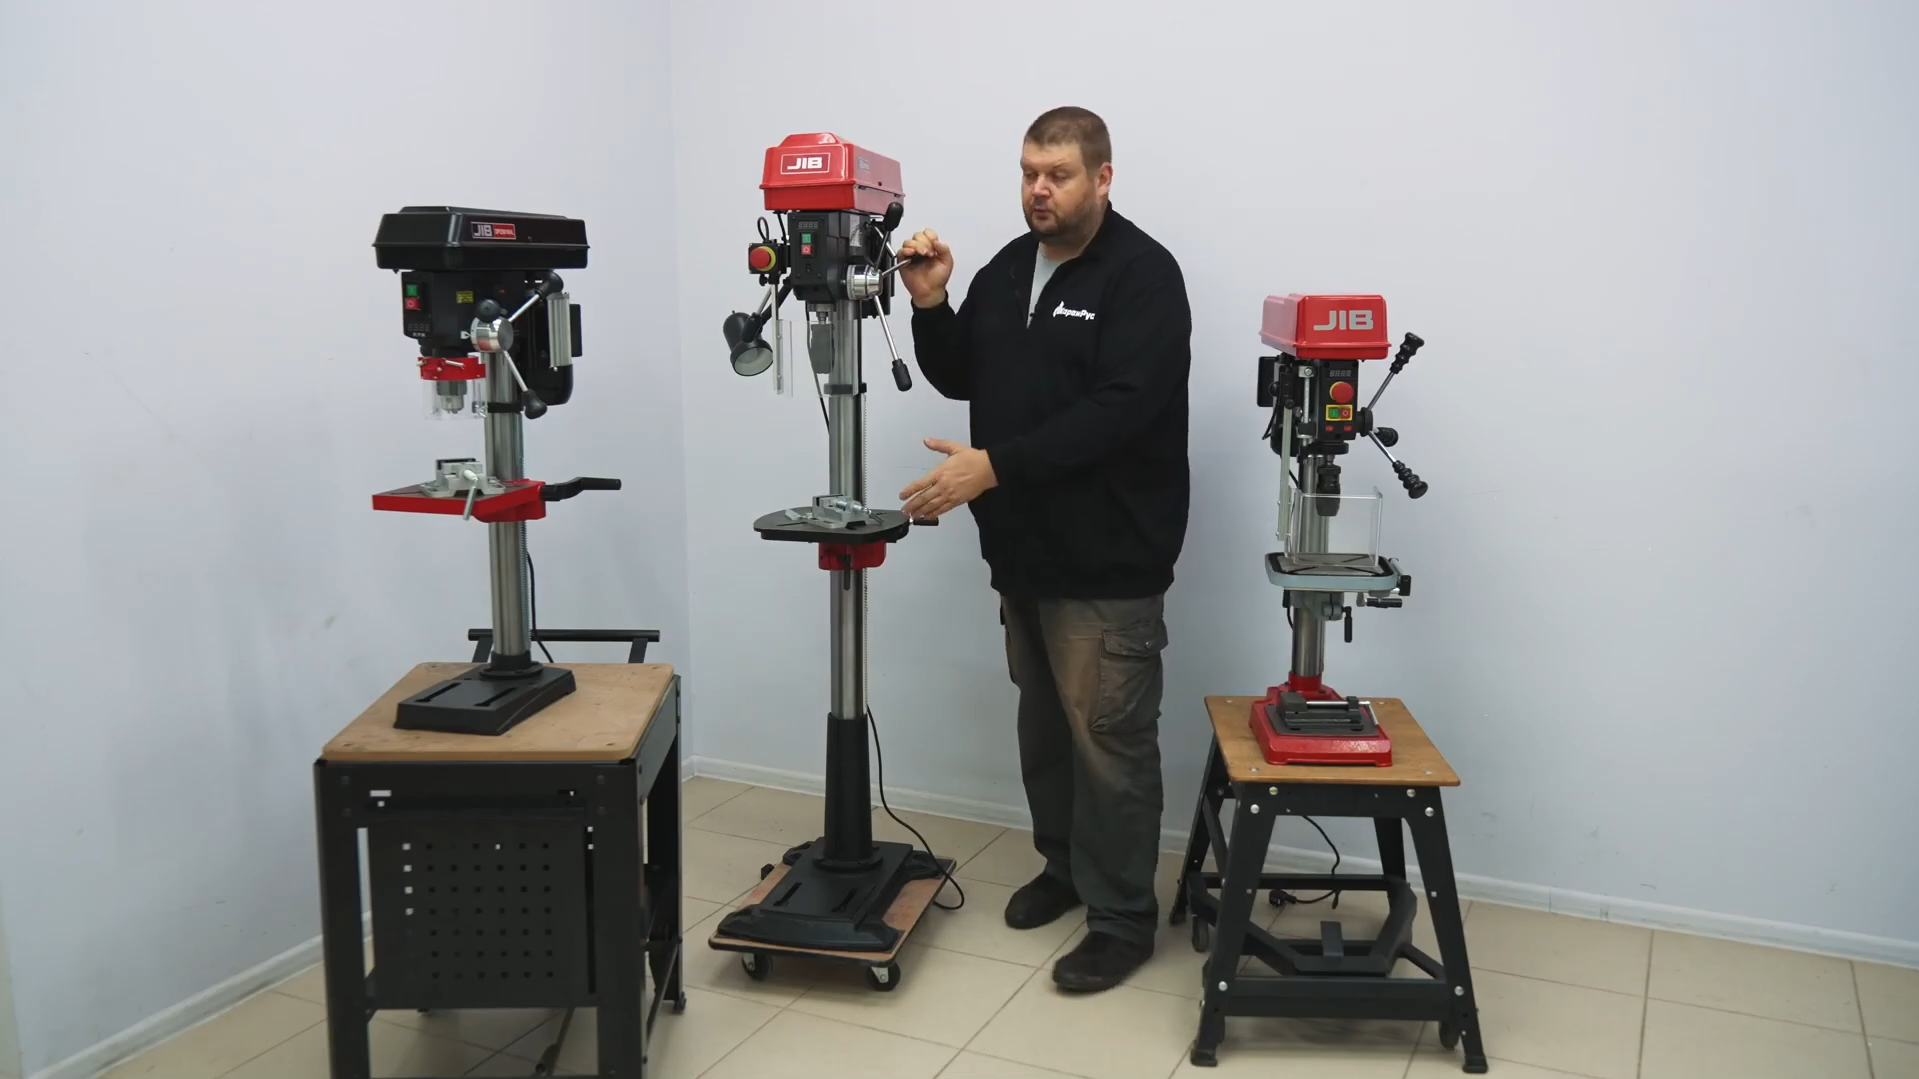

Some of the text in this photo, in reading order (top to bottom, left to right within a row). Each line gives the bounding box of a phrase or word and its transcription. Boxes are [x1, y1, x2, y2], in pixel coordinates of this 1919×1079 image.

[787, 157, 822, 170] JIB
[473, 224, 493, 237] JIB
[1313, 309, 1374, 331] JIB
